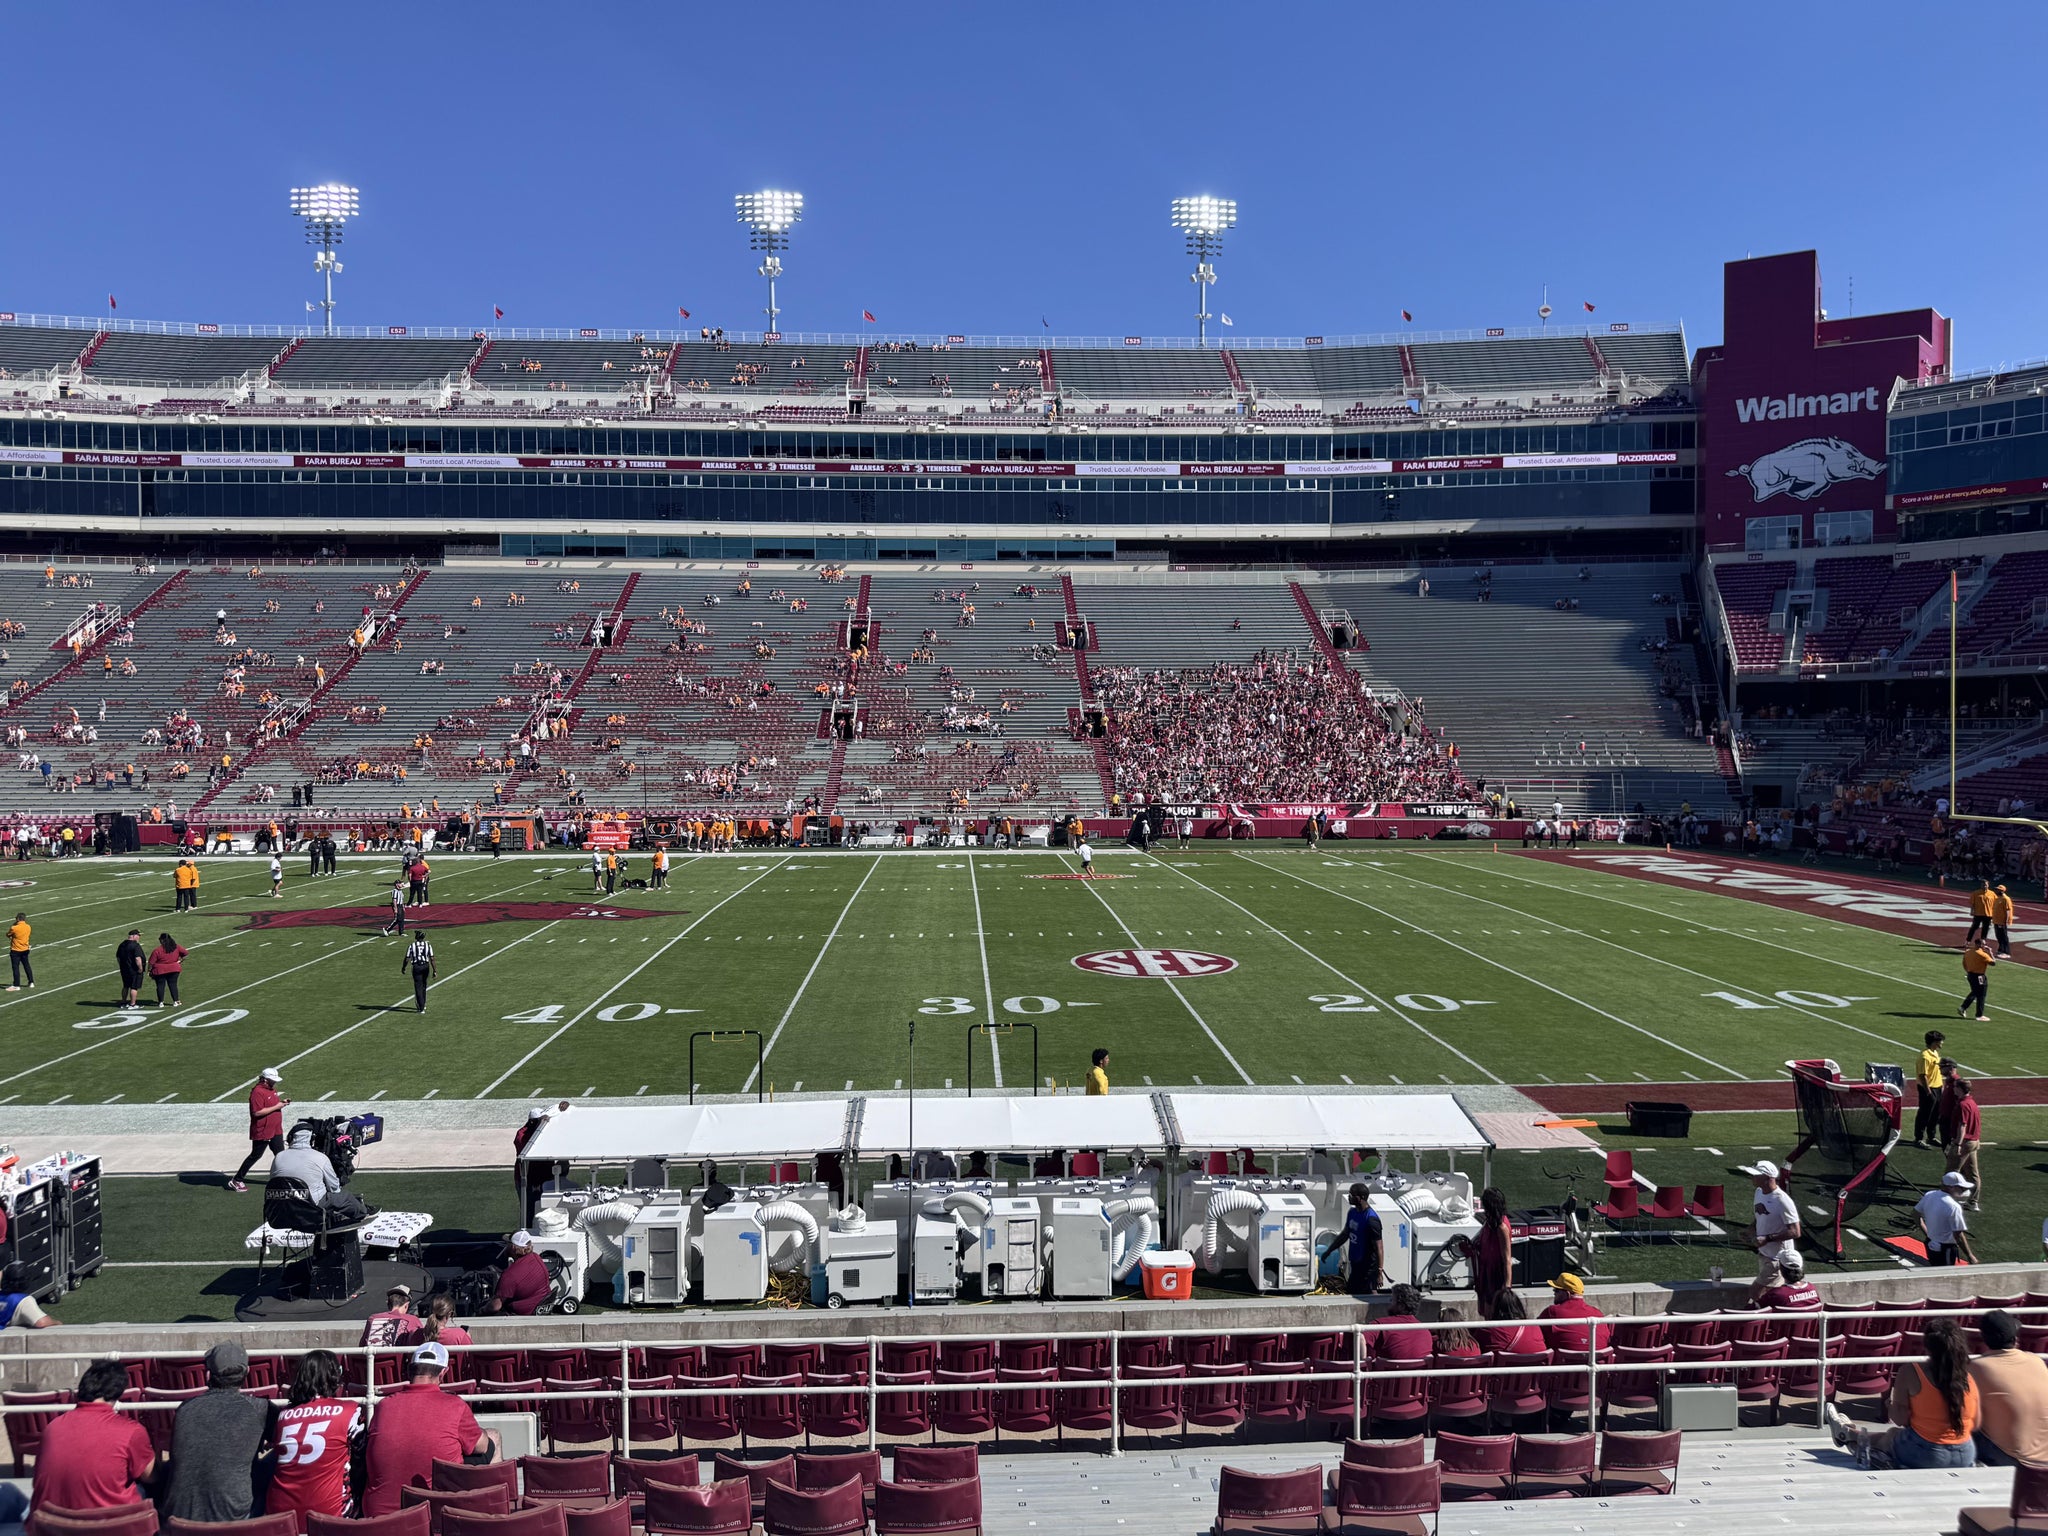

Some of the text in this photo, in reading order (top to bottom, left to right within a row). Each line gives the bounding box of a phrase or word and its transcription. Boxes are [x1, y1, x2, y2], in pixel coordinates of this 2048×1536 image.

[1736, 386, 1879, 423] Walmart
[75, 454, 100, 464] FARM
[102, 454, 138, 464] BUREAU
[305, 457, 328, 465] FARM
[330, 457, 362, 465] BUREAU
[1618, 453, 1677, 462] RAZORBACKS
[603, 460, 613, 468] VS
[754, 462, 763, 470] VS
[901, 464, 910, 472] VS
[981, 465, 1002, 473] FARM
[1004, 465, 1034, 473] BUREAU
[1403, 462, 1425, 470] FARM
[1427, 460, 1460, 469] BUREAU
[1951, 487, 2007, 498] mercy.net/GoHogs
[657, 822, 669, 835] T
[418, 945, 425, 956] F
[1085, 950, 1217, 976] SEC
[266, 1188, 308, 1200] CHAPMAN
[1160, 1272, 1177, 1291] G
[278, 1405, 344, 1421] WOODARD
[278, 1420, 332, 1465] 55
